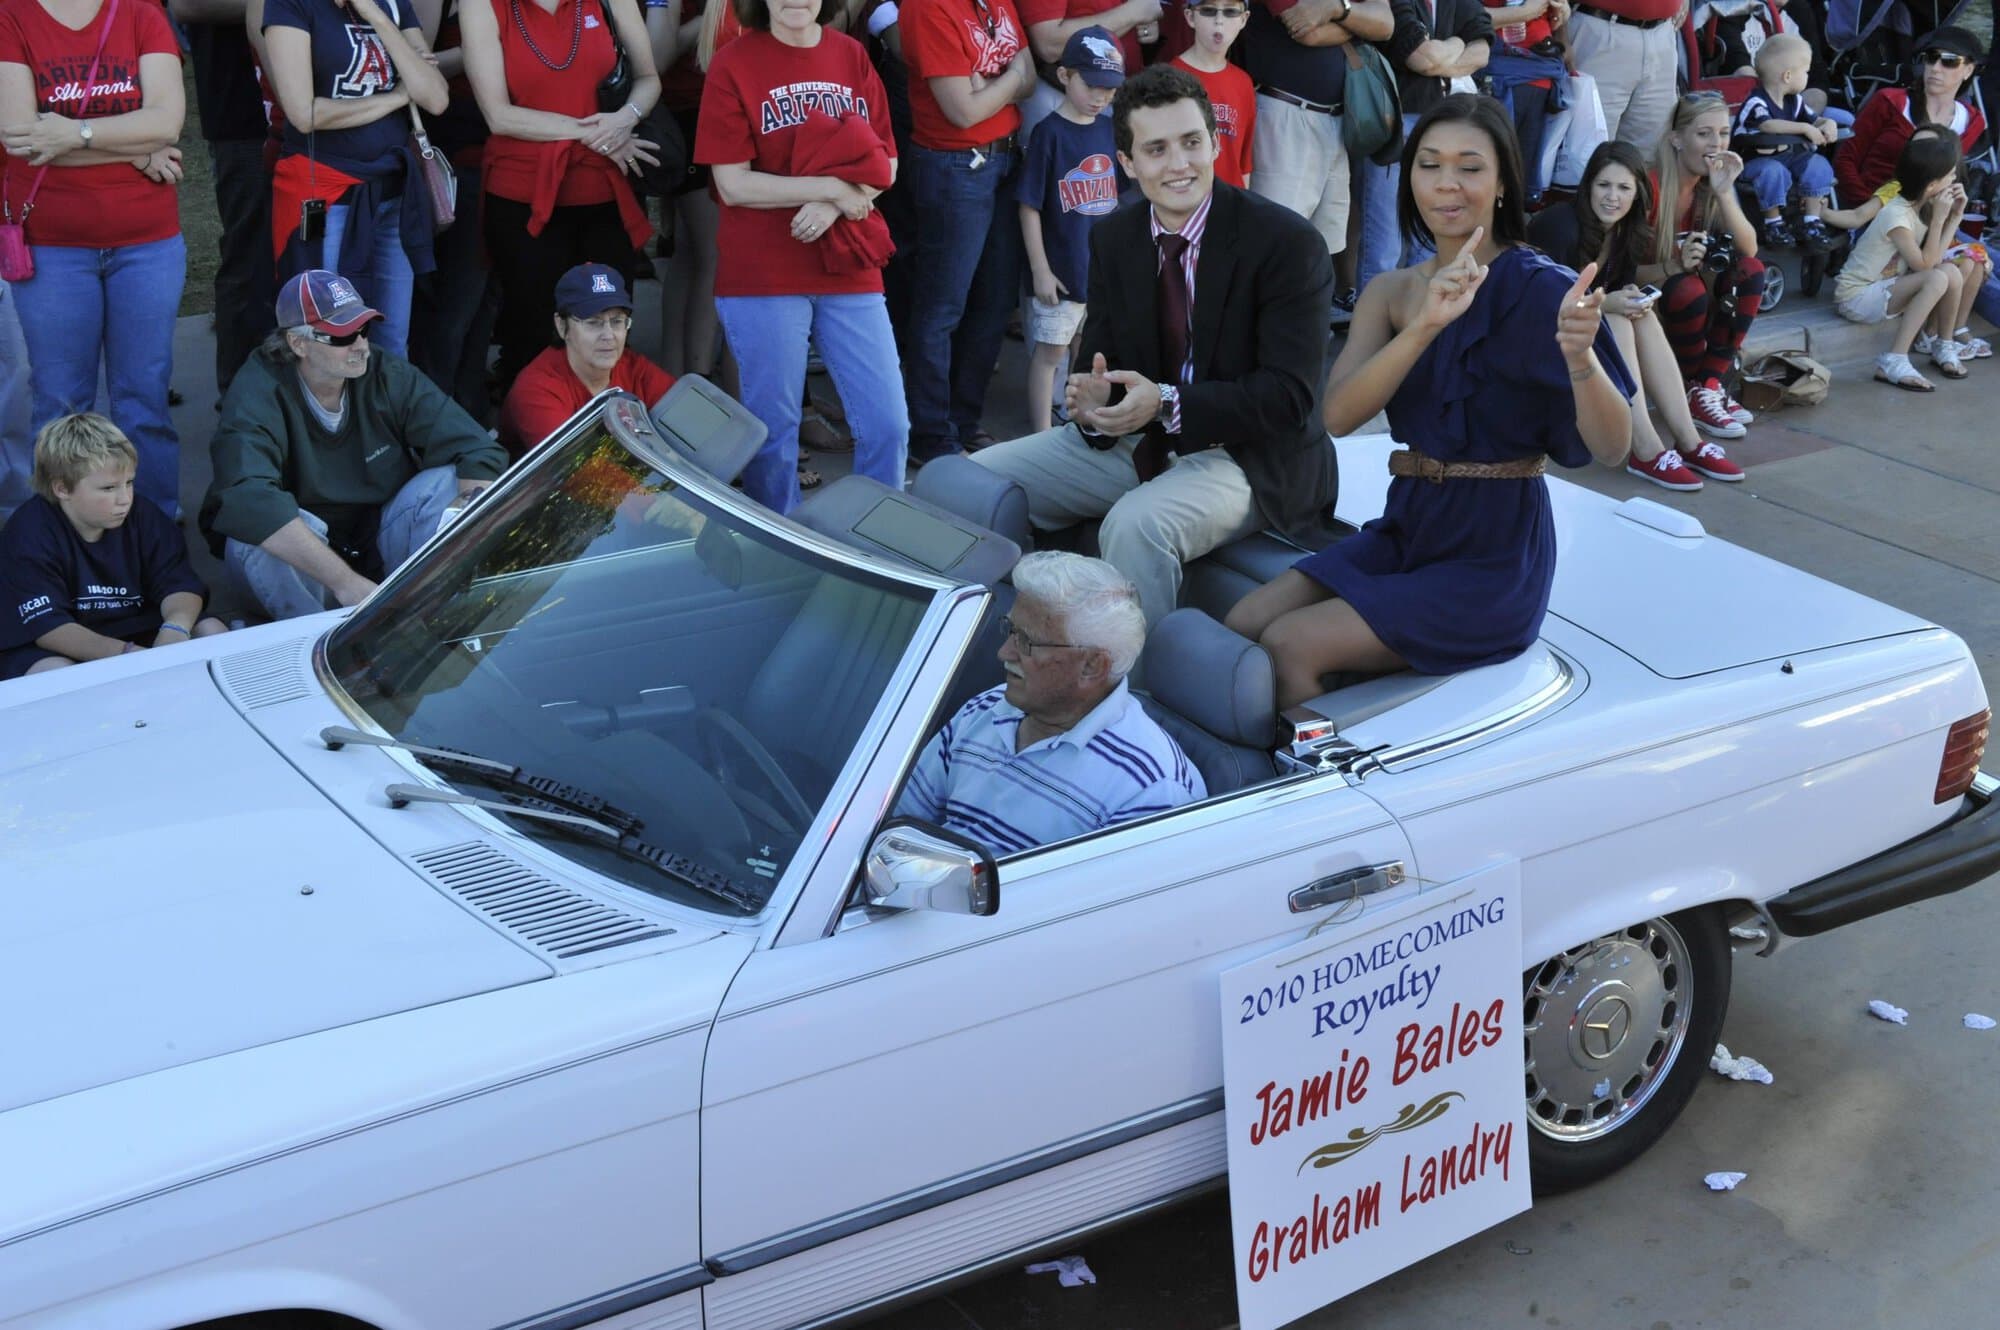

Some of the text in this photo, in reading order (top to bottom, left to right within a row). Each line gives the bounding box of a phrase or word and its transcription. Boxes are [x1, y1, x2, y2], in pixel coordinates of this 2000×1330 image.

[48, 76, 135, 103] Alumni
[332, 24, 399, 99] A
[769, 81, 853, 99] THE UNIVERSITY OF
[761, 92, 870, 135] ARIZONA
[591, 273, 617, 293] A
[1240, 896, 1506, 1025] 2010 HOMECOMING
[1311, 963, 1442, 1039] Royalty
[1250, 998, 1505, 1146] Jamie Bales
[1248, 1121, 1513, 1283] Graham Landry
